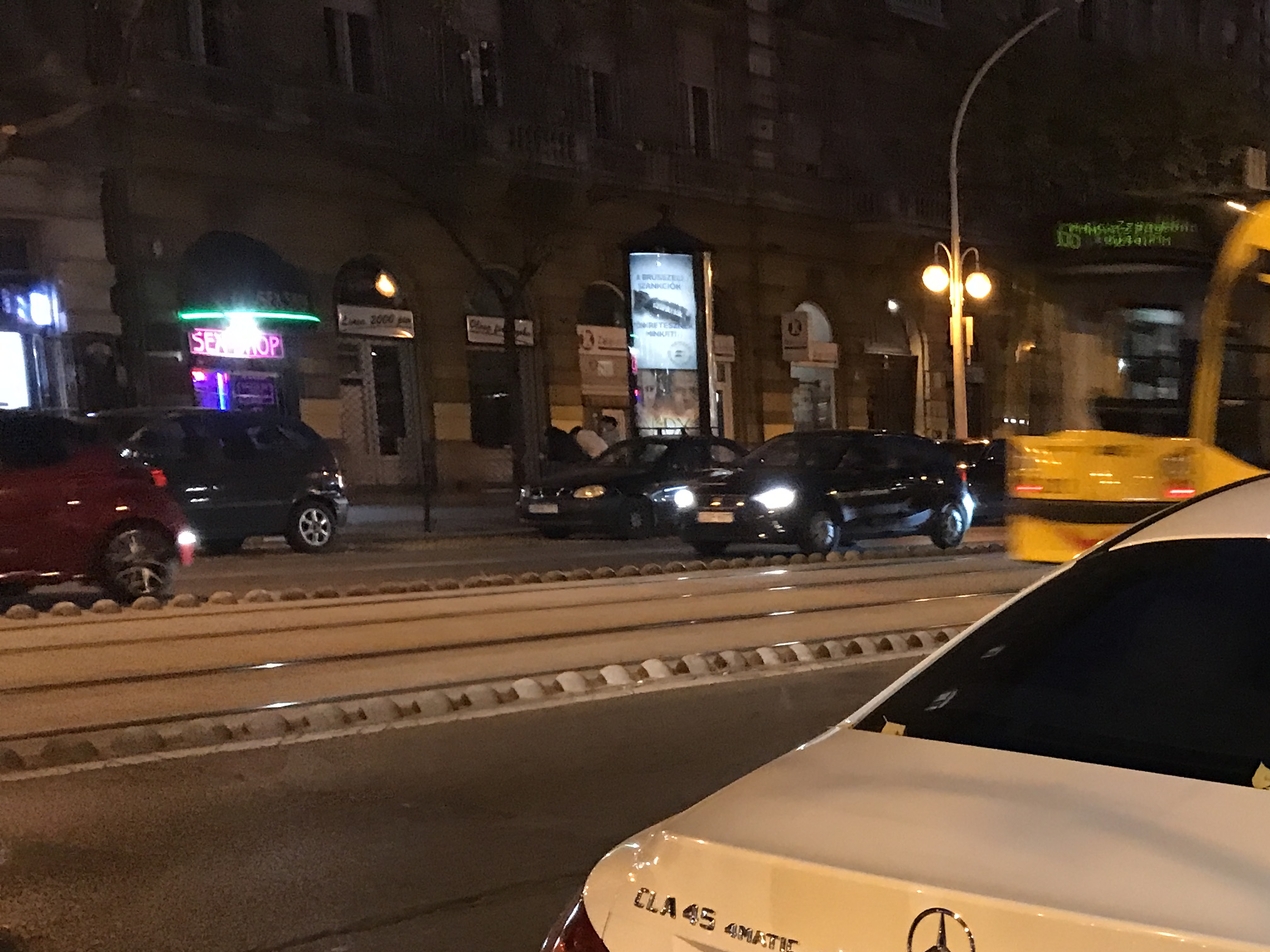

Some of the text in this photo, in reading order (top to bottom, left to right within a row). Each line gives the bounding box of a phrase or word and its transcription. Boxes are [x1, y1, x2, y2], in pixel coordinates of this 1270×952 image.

[234, 333, 280, 356] HOP
[633, 887, 677, 920] CLA
[682, 903, 717, 931] 45
